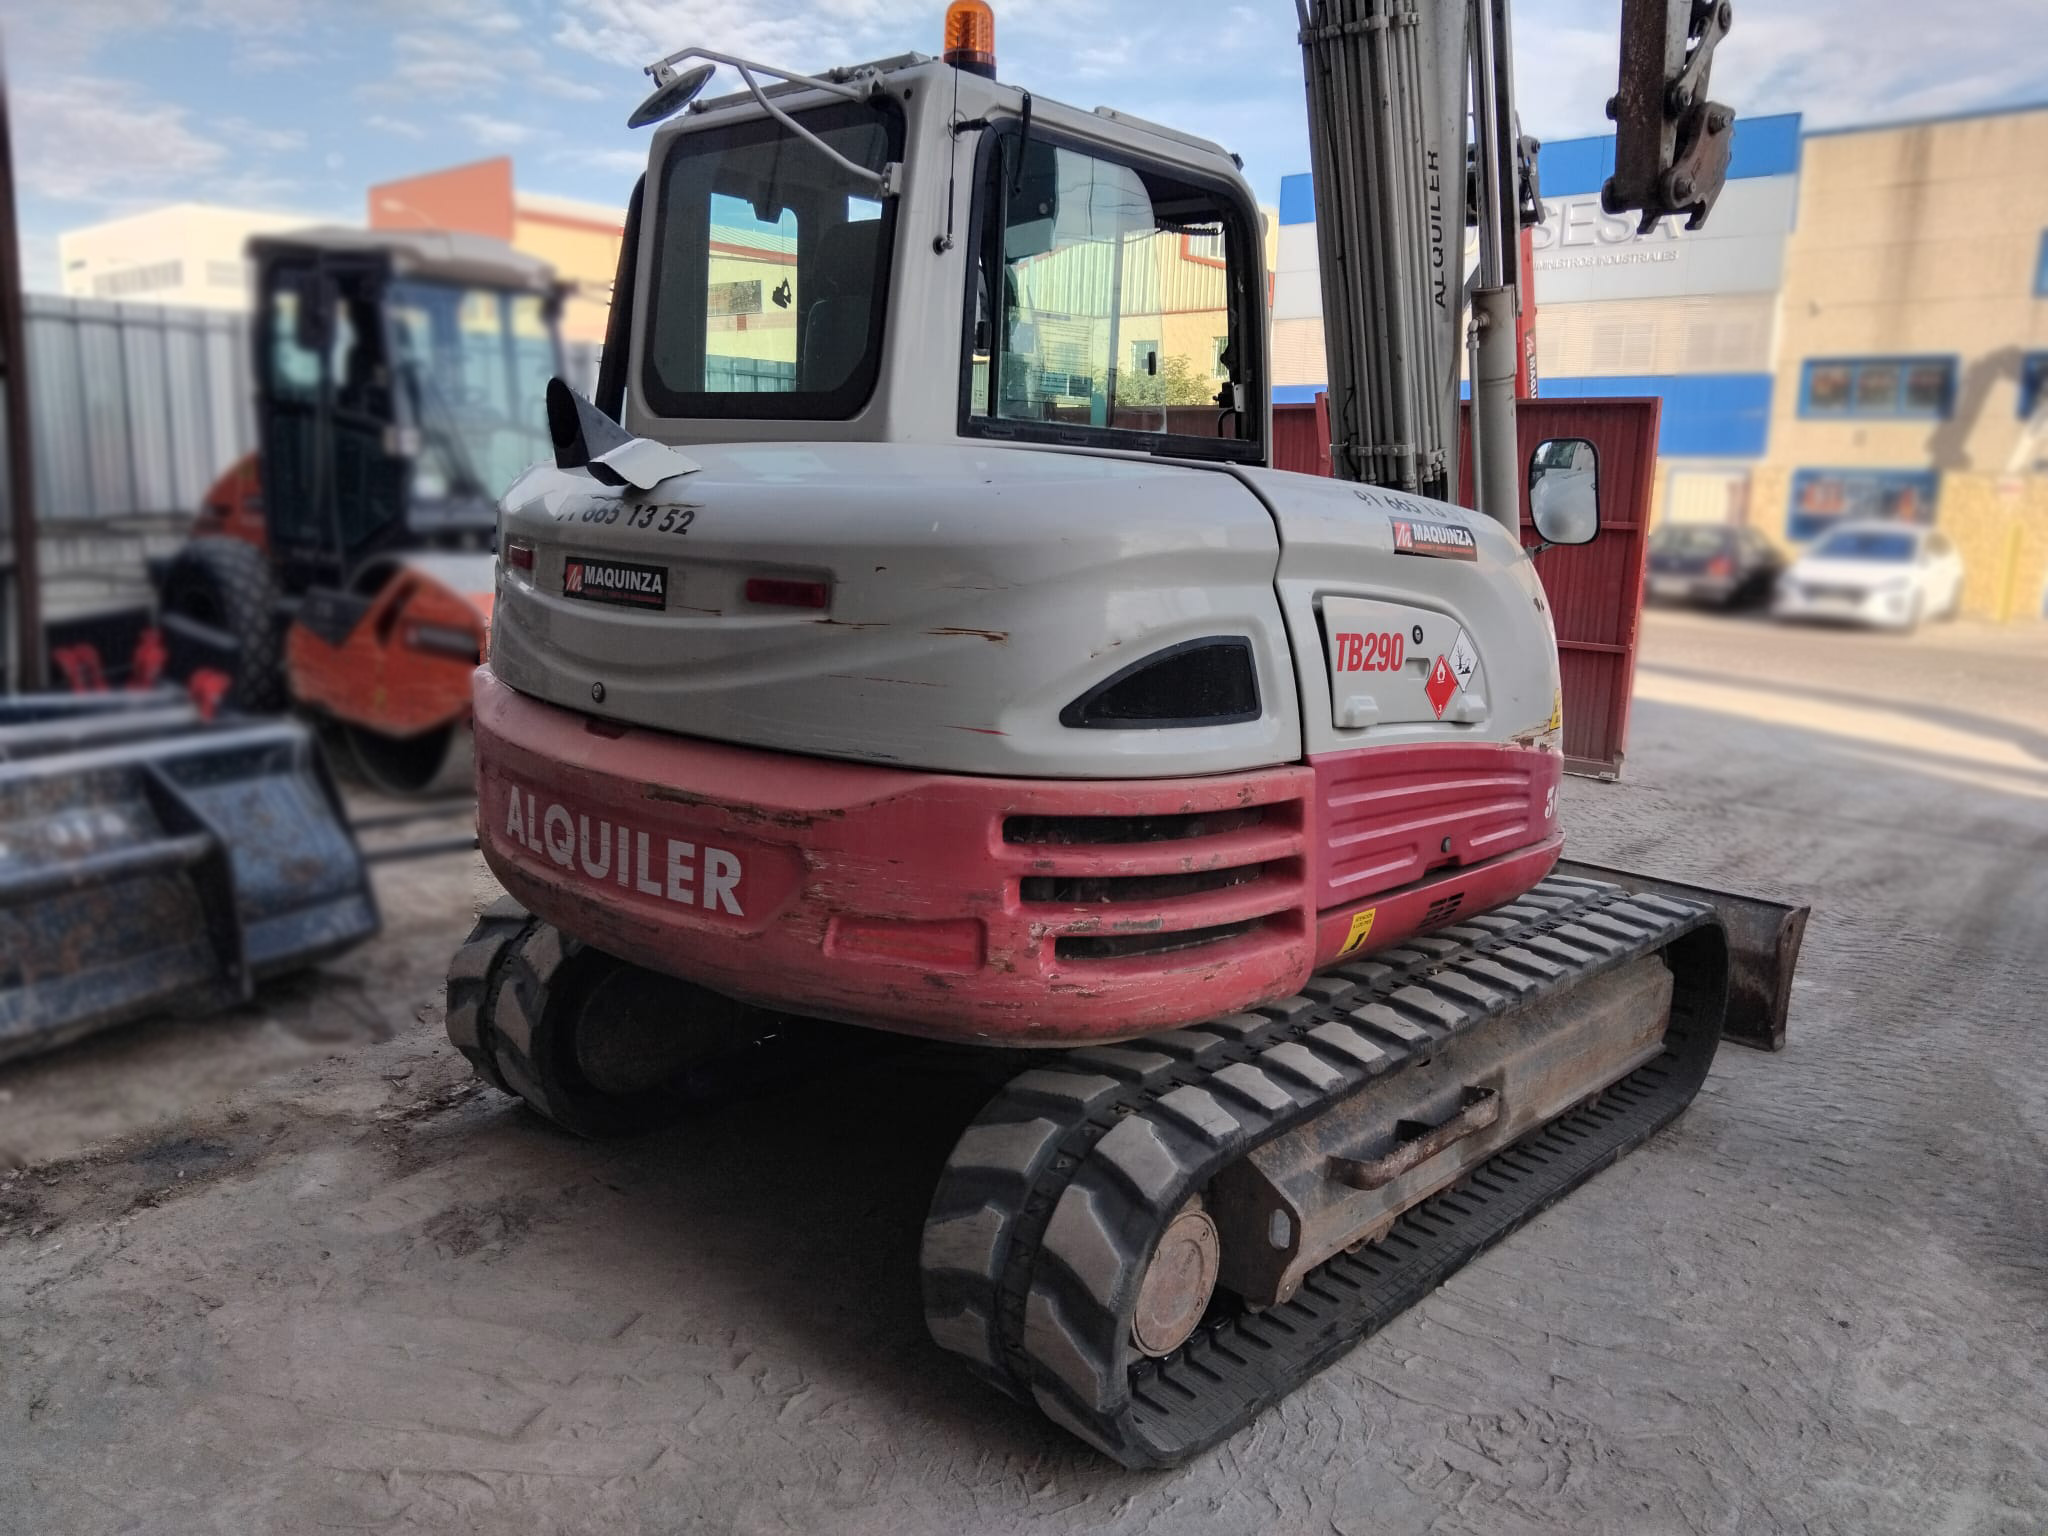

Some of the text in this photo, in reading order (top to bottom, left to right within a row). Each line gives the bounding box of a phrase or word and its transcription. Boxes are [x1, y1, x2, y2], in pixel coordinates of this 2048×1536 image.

[1427, 150, 1447, 309] ALQUILER
[1533, 250, 1678, 272] MINISTROS INDUSTRIALES
[1353, 489, 1383, 508] 91
[1384, 495, 1421, 514] 665
[627, 504, 658, 529] 13
[657, 508, 696, 536] 52
[1411, 522, 1474, 548] MAQUINZA
[584, 565, 664, 594] MAQUINZA
[1335, 632, 1404, 673] TB290
[506, 785, 745, 917] ALQUILER
